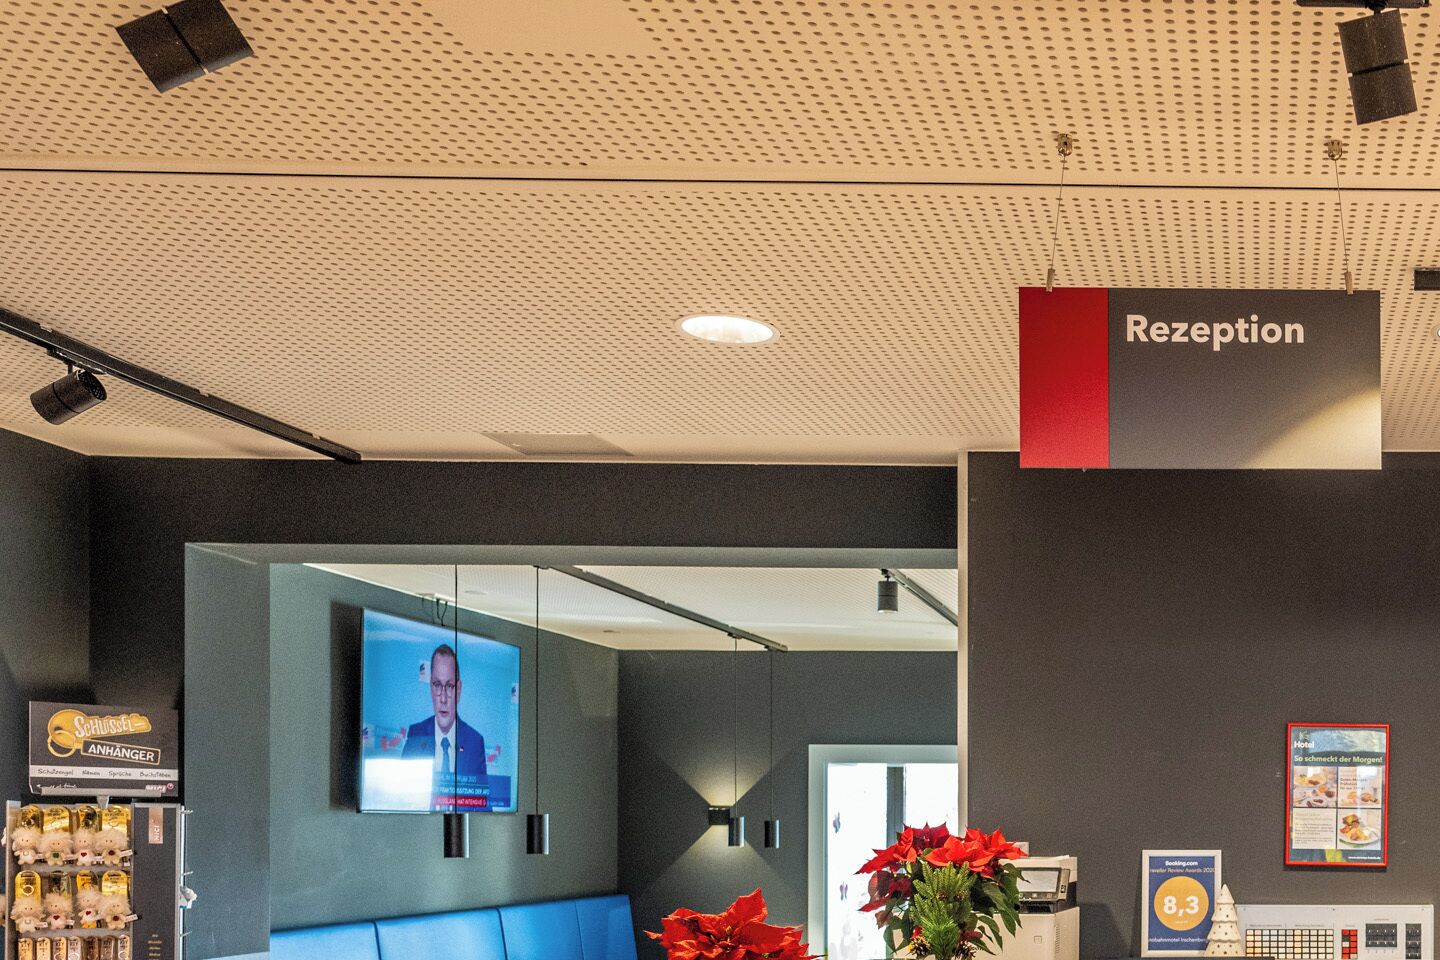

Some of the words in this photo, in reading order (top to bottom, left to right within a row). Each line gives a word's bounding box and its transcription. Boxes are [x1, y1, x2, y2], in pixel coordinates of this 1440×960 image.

[1126, 314, 1304, 351] Rezeption
[88, 744, 155, 762] ANHÄNGER
[1305, 755, 1338, 763] schmeckt
[1353, 756, 1382, 764] Morgen!
[1163, 895, 1199, 917] 8,3
